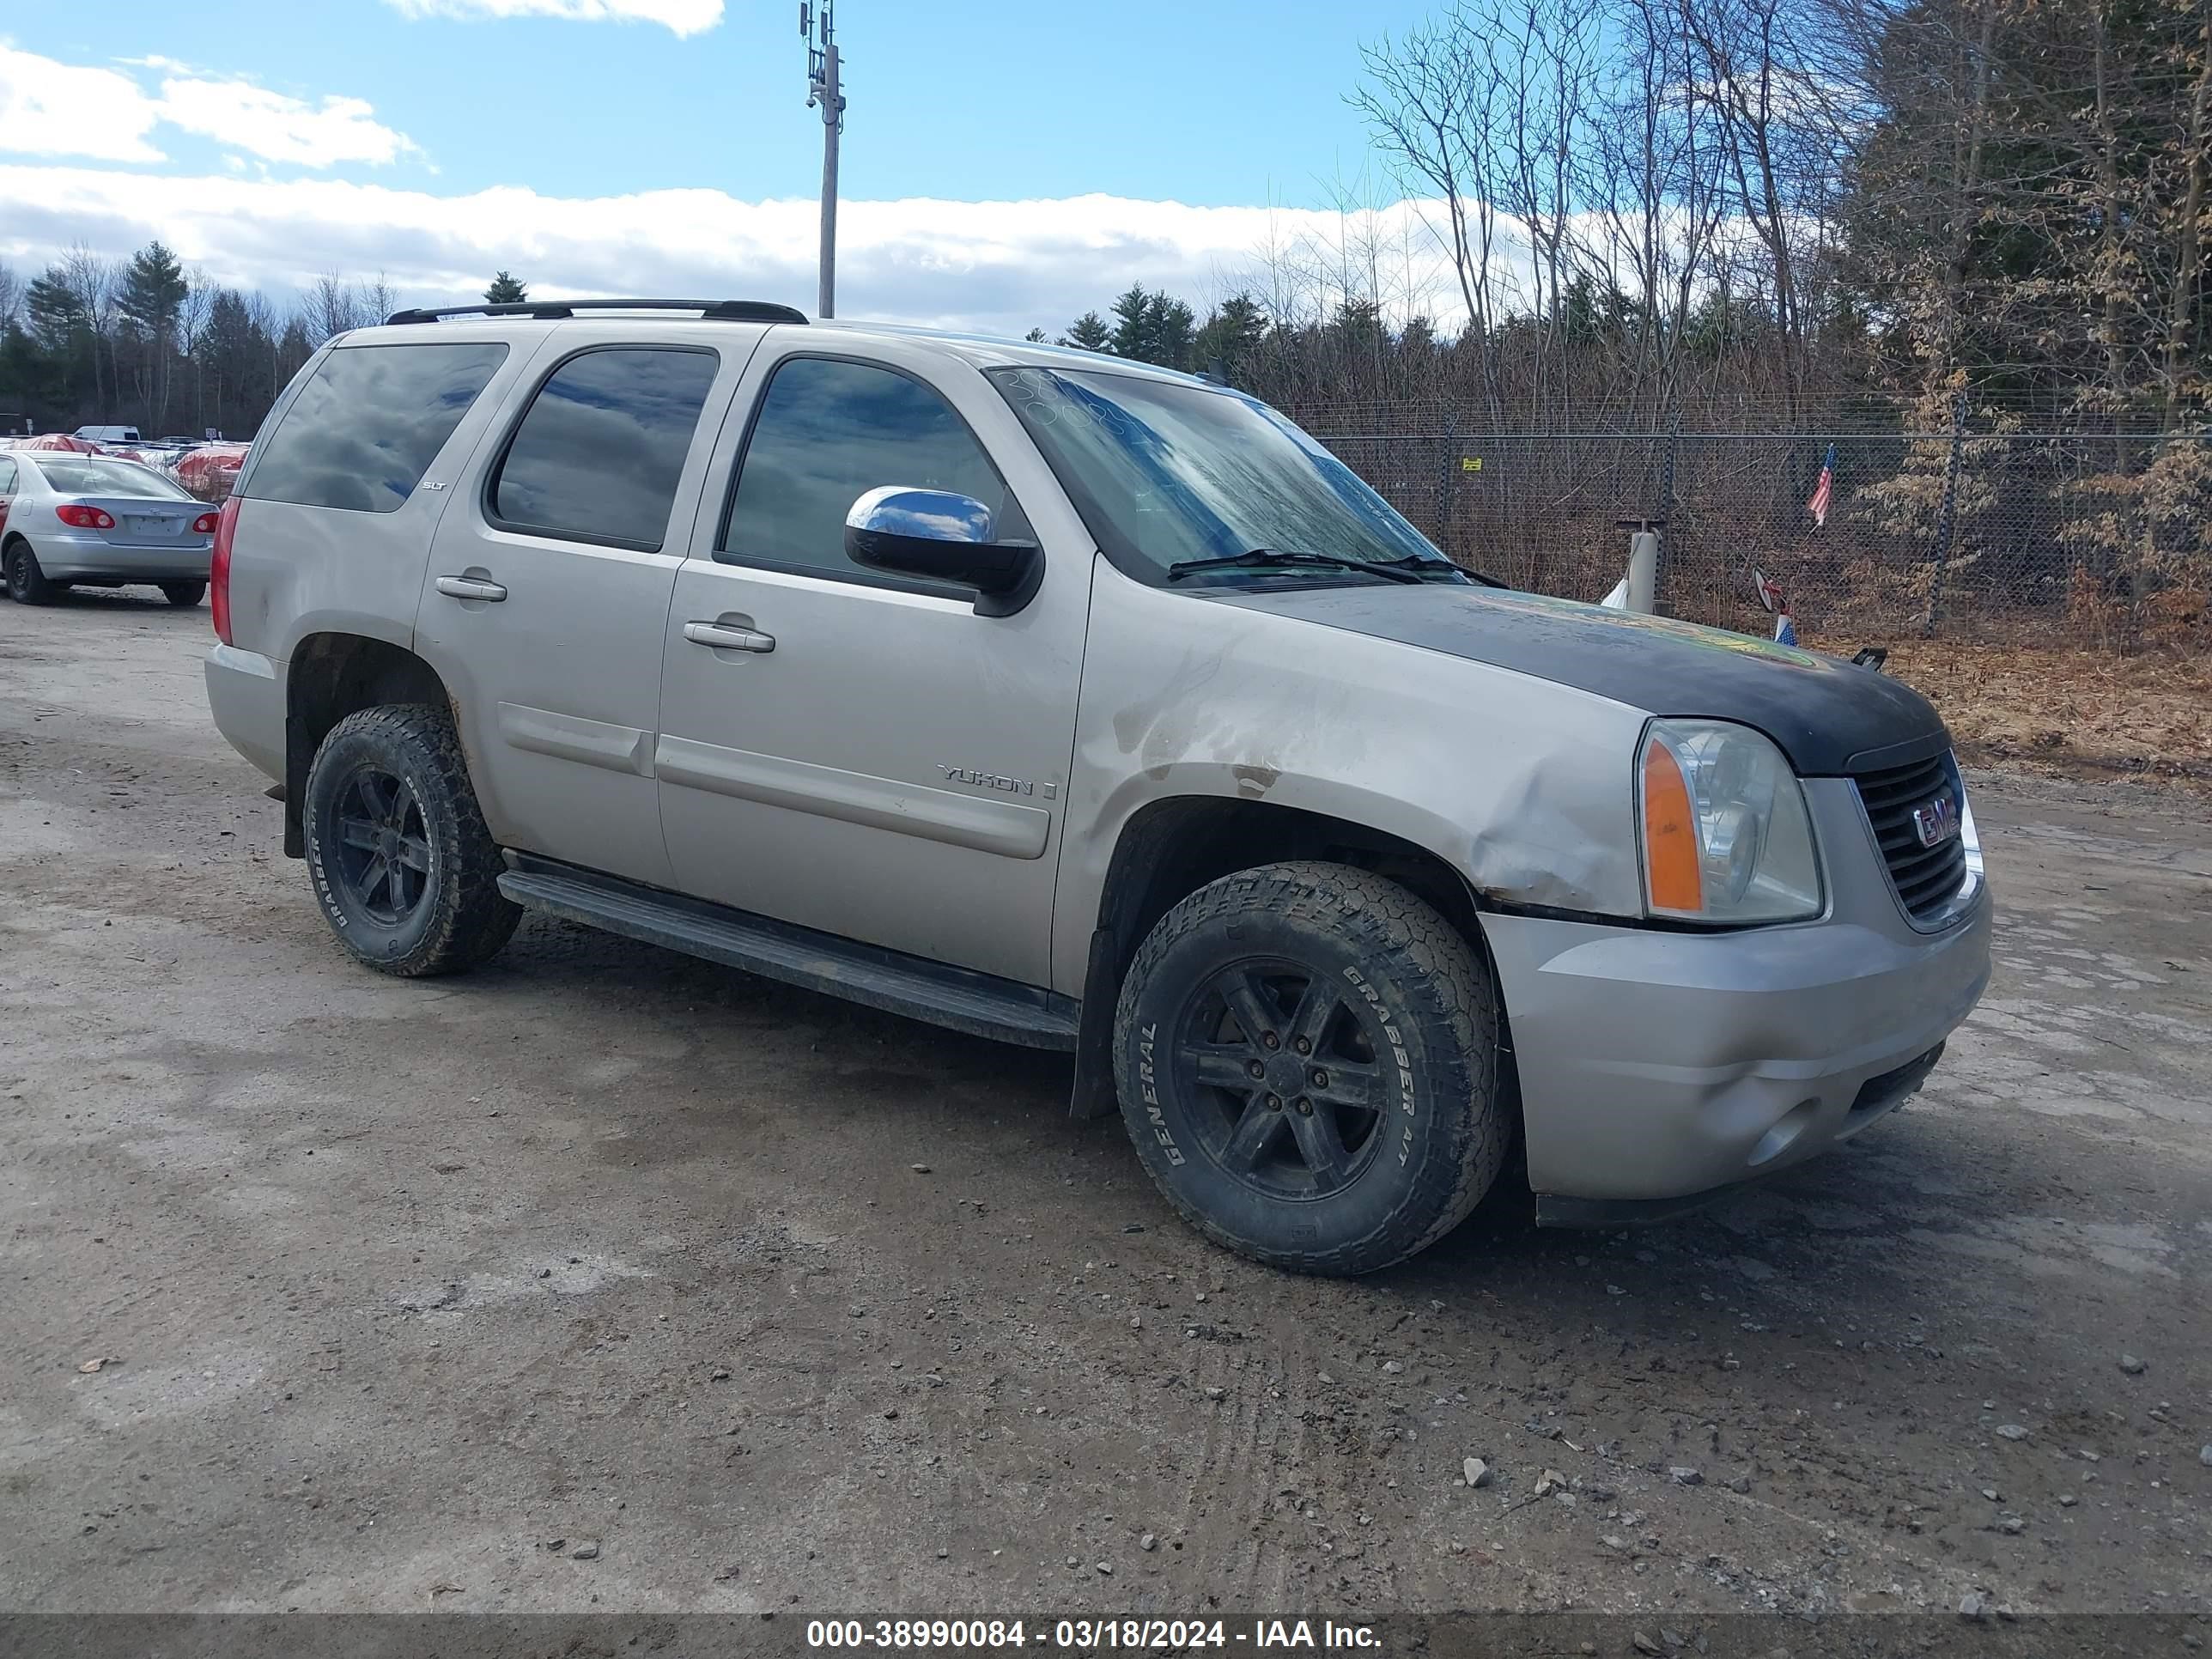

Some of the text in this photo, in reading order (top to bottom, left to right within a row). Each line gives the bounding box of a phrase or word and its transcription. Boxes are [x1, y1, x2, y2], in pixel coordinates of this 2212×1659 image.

[422, 482, 447, 490] SLT
[936, 763, 1033, 795] YUKON
[1913, 798, 1960, 848] GMC
[311, 836, 348, 927] GRABBER
[1140, 1023, 1186, 1167] GENERAL
[1343, 966, 1415, 1169] GRABBER A/T
